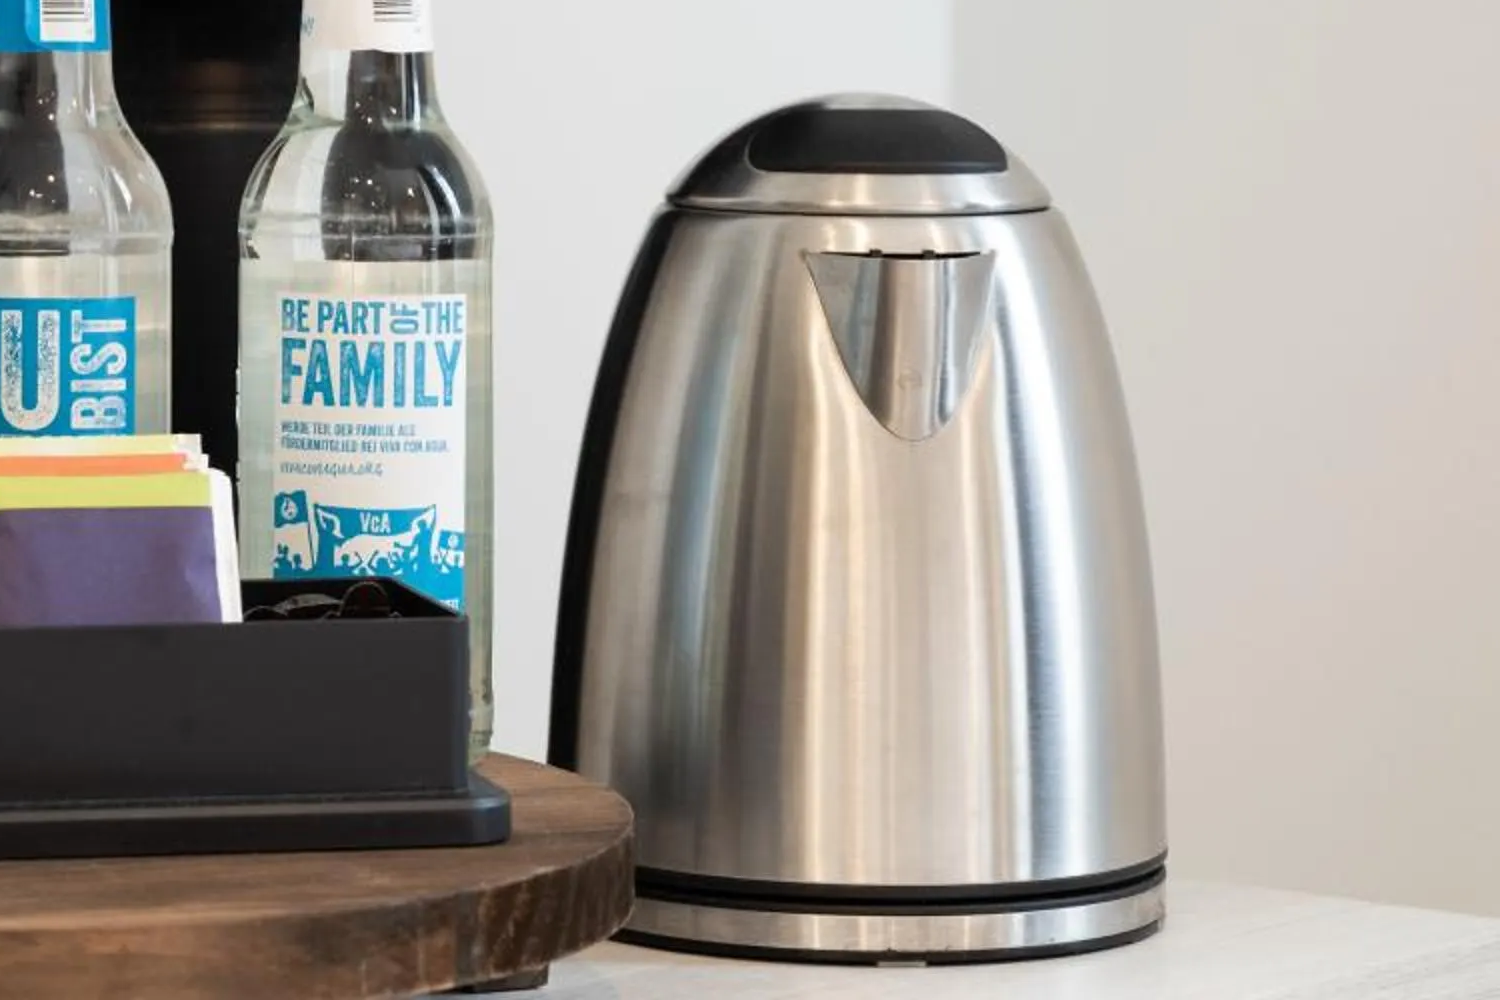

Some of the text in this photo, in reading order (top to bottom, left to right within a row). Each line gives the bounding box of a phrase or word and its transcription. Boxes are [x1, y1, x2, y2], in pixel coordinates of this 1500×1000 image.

[281, 300, 463, 335] BE PART OF THE
[70, 309, 128, 431] BIST
[281, 337, 463, 408] FAMILY
